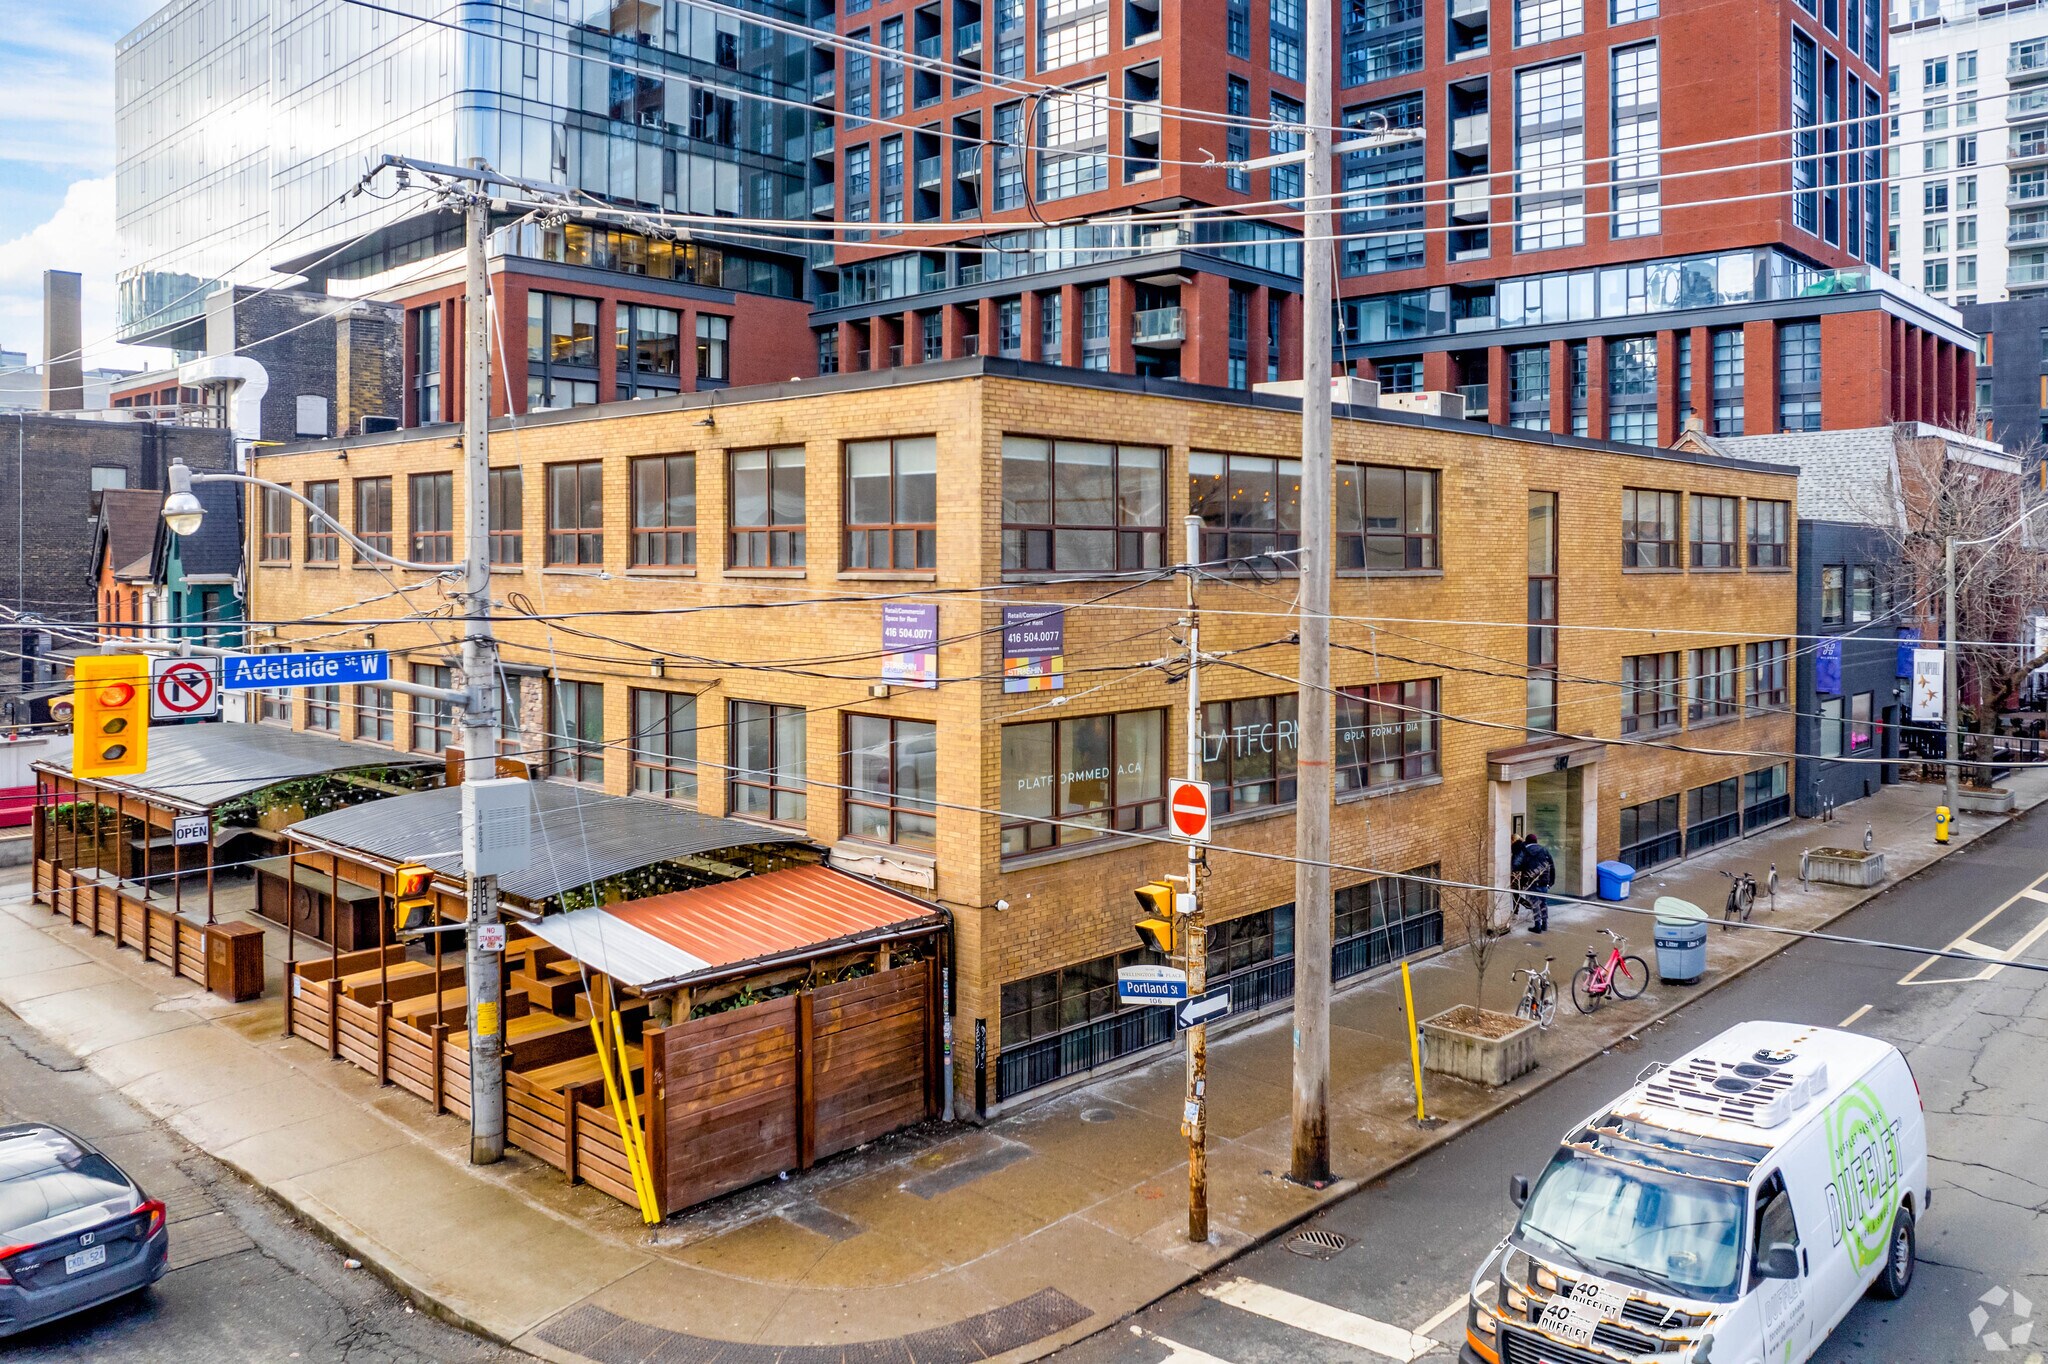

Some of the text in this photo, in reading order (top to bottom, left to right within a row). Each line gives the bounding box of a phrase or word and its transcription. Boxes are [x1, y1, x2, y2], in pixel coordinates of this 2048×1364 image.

[540, 212, 568, 230] S2230
[885, 627, 933, 639] 416 504.0077
[1008, 631, 1060, 643] 416 504.0077
[234, 655, 339, 681] Adelaide
[361, 654, 379, 674] W
[176, 826, 207, 839] OPEN
[479, 935, 503, 943] STANDING
[1665, 940, 1679, 948] Litter
[1127, 982, 1179, 994] Portland St
[1824, 1119, 1903, 1248] DUFFLET
[15, 1263, 40, 1273] CIVIC
[1576, 1283, 1599, 1297] 40
[1547, 1304, 1570, 1320] 40
